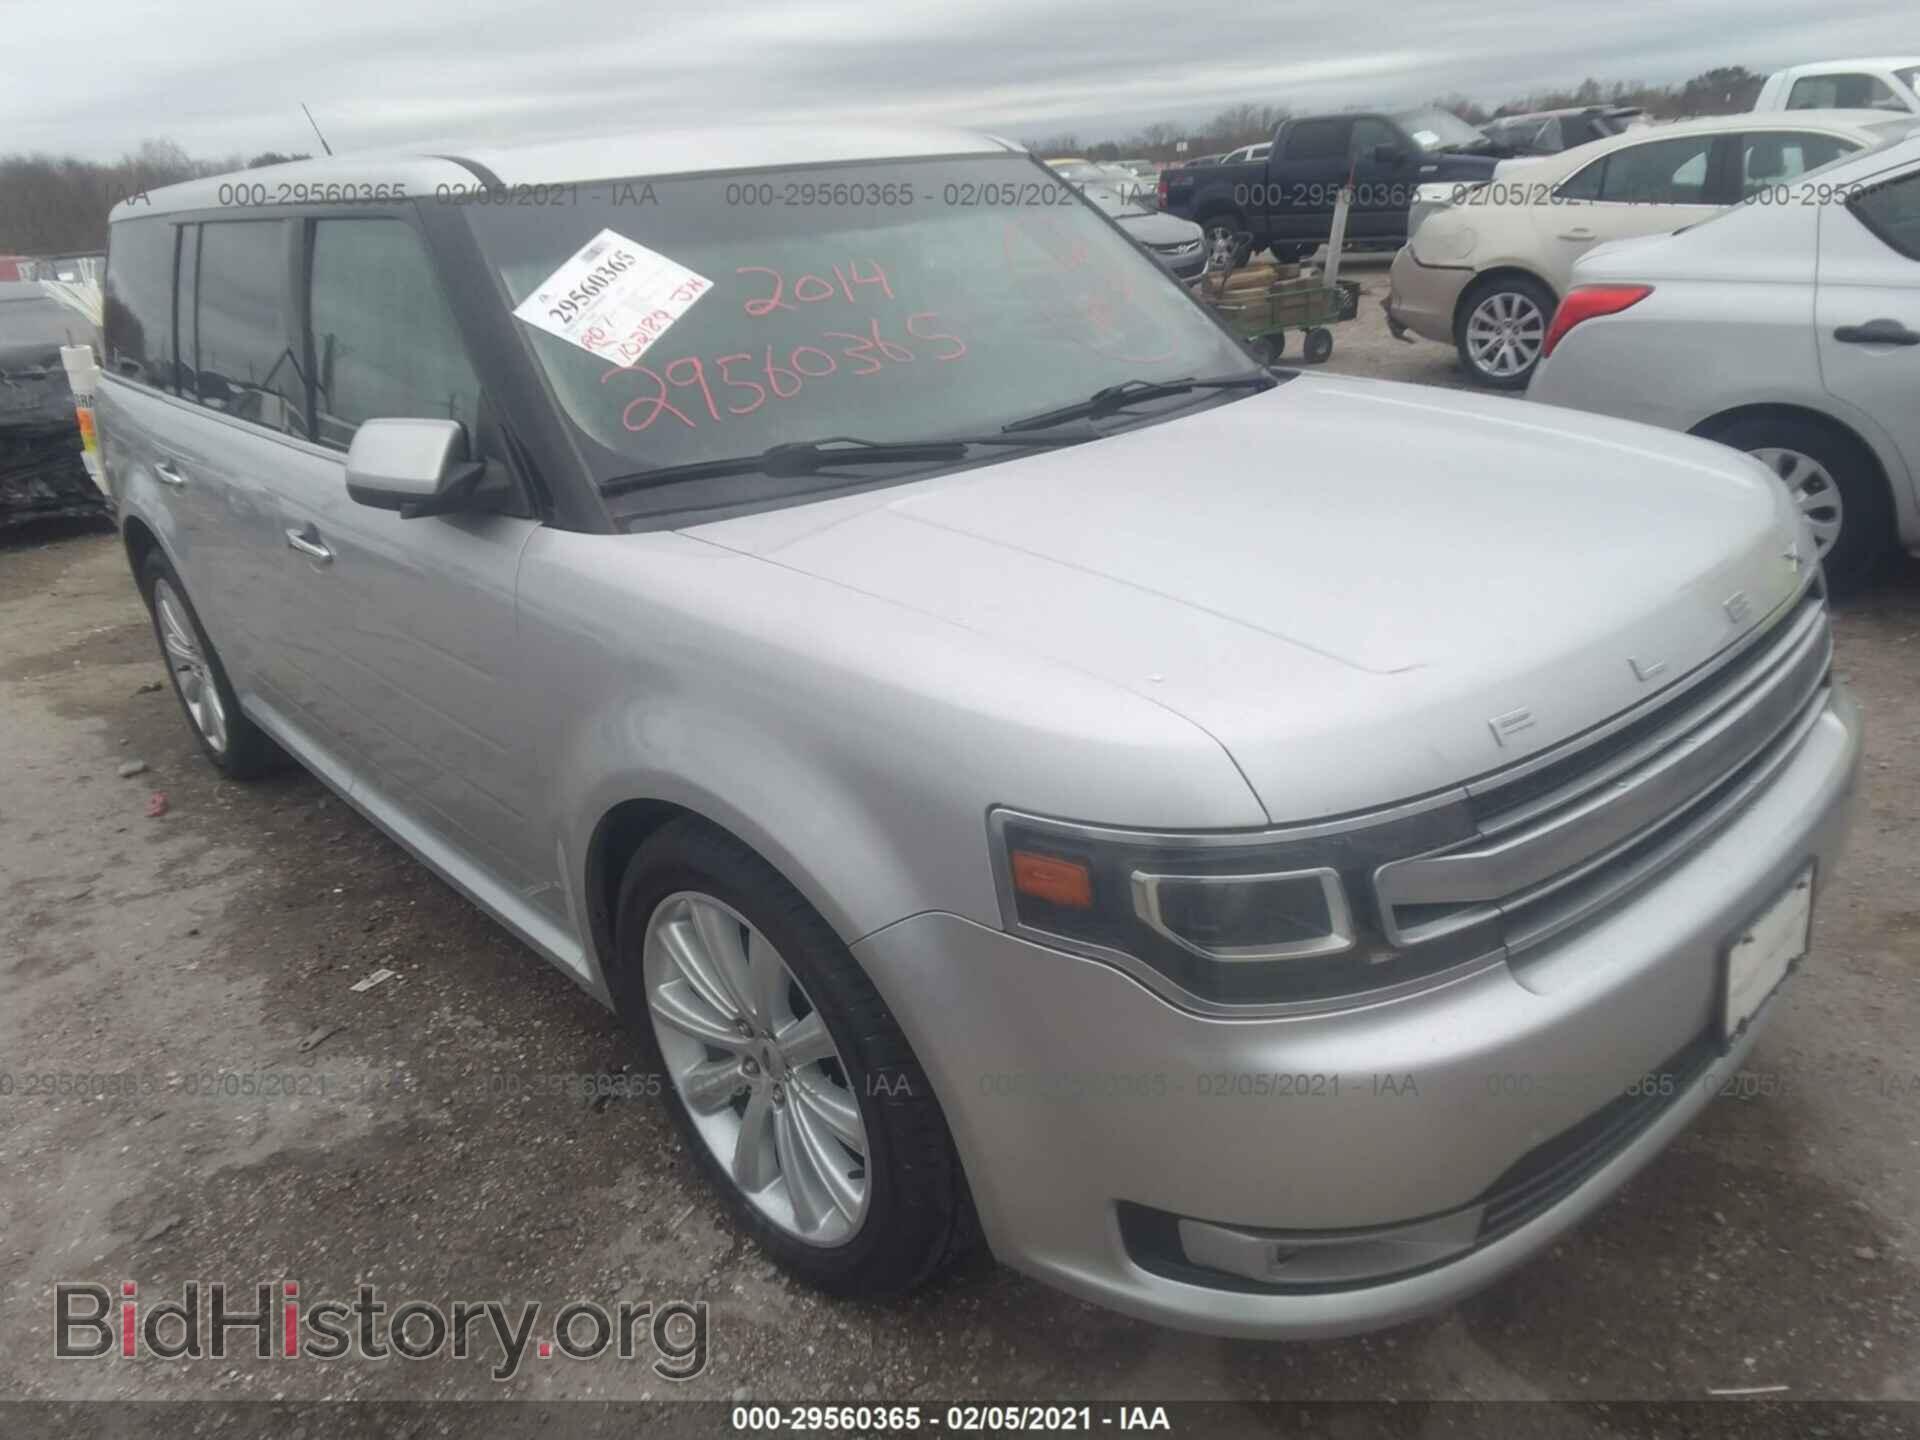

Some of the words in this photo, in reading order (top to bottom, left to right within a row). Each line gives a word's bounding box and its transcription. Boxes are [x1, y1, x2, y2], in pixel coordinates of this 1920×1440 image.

[549, 250, 637, 325] 29560365
[736, 259, 895, 315] 2014
[601, 312, 967, 432] 29560365
